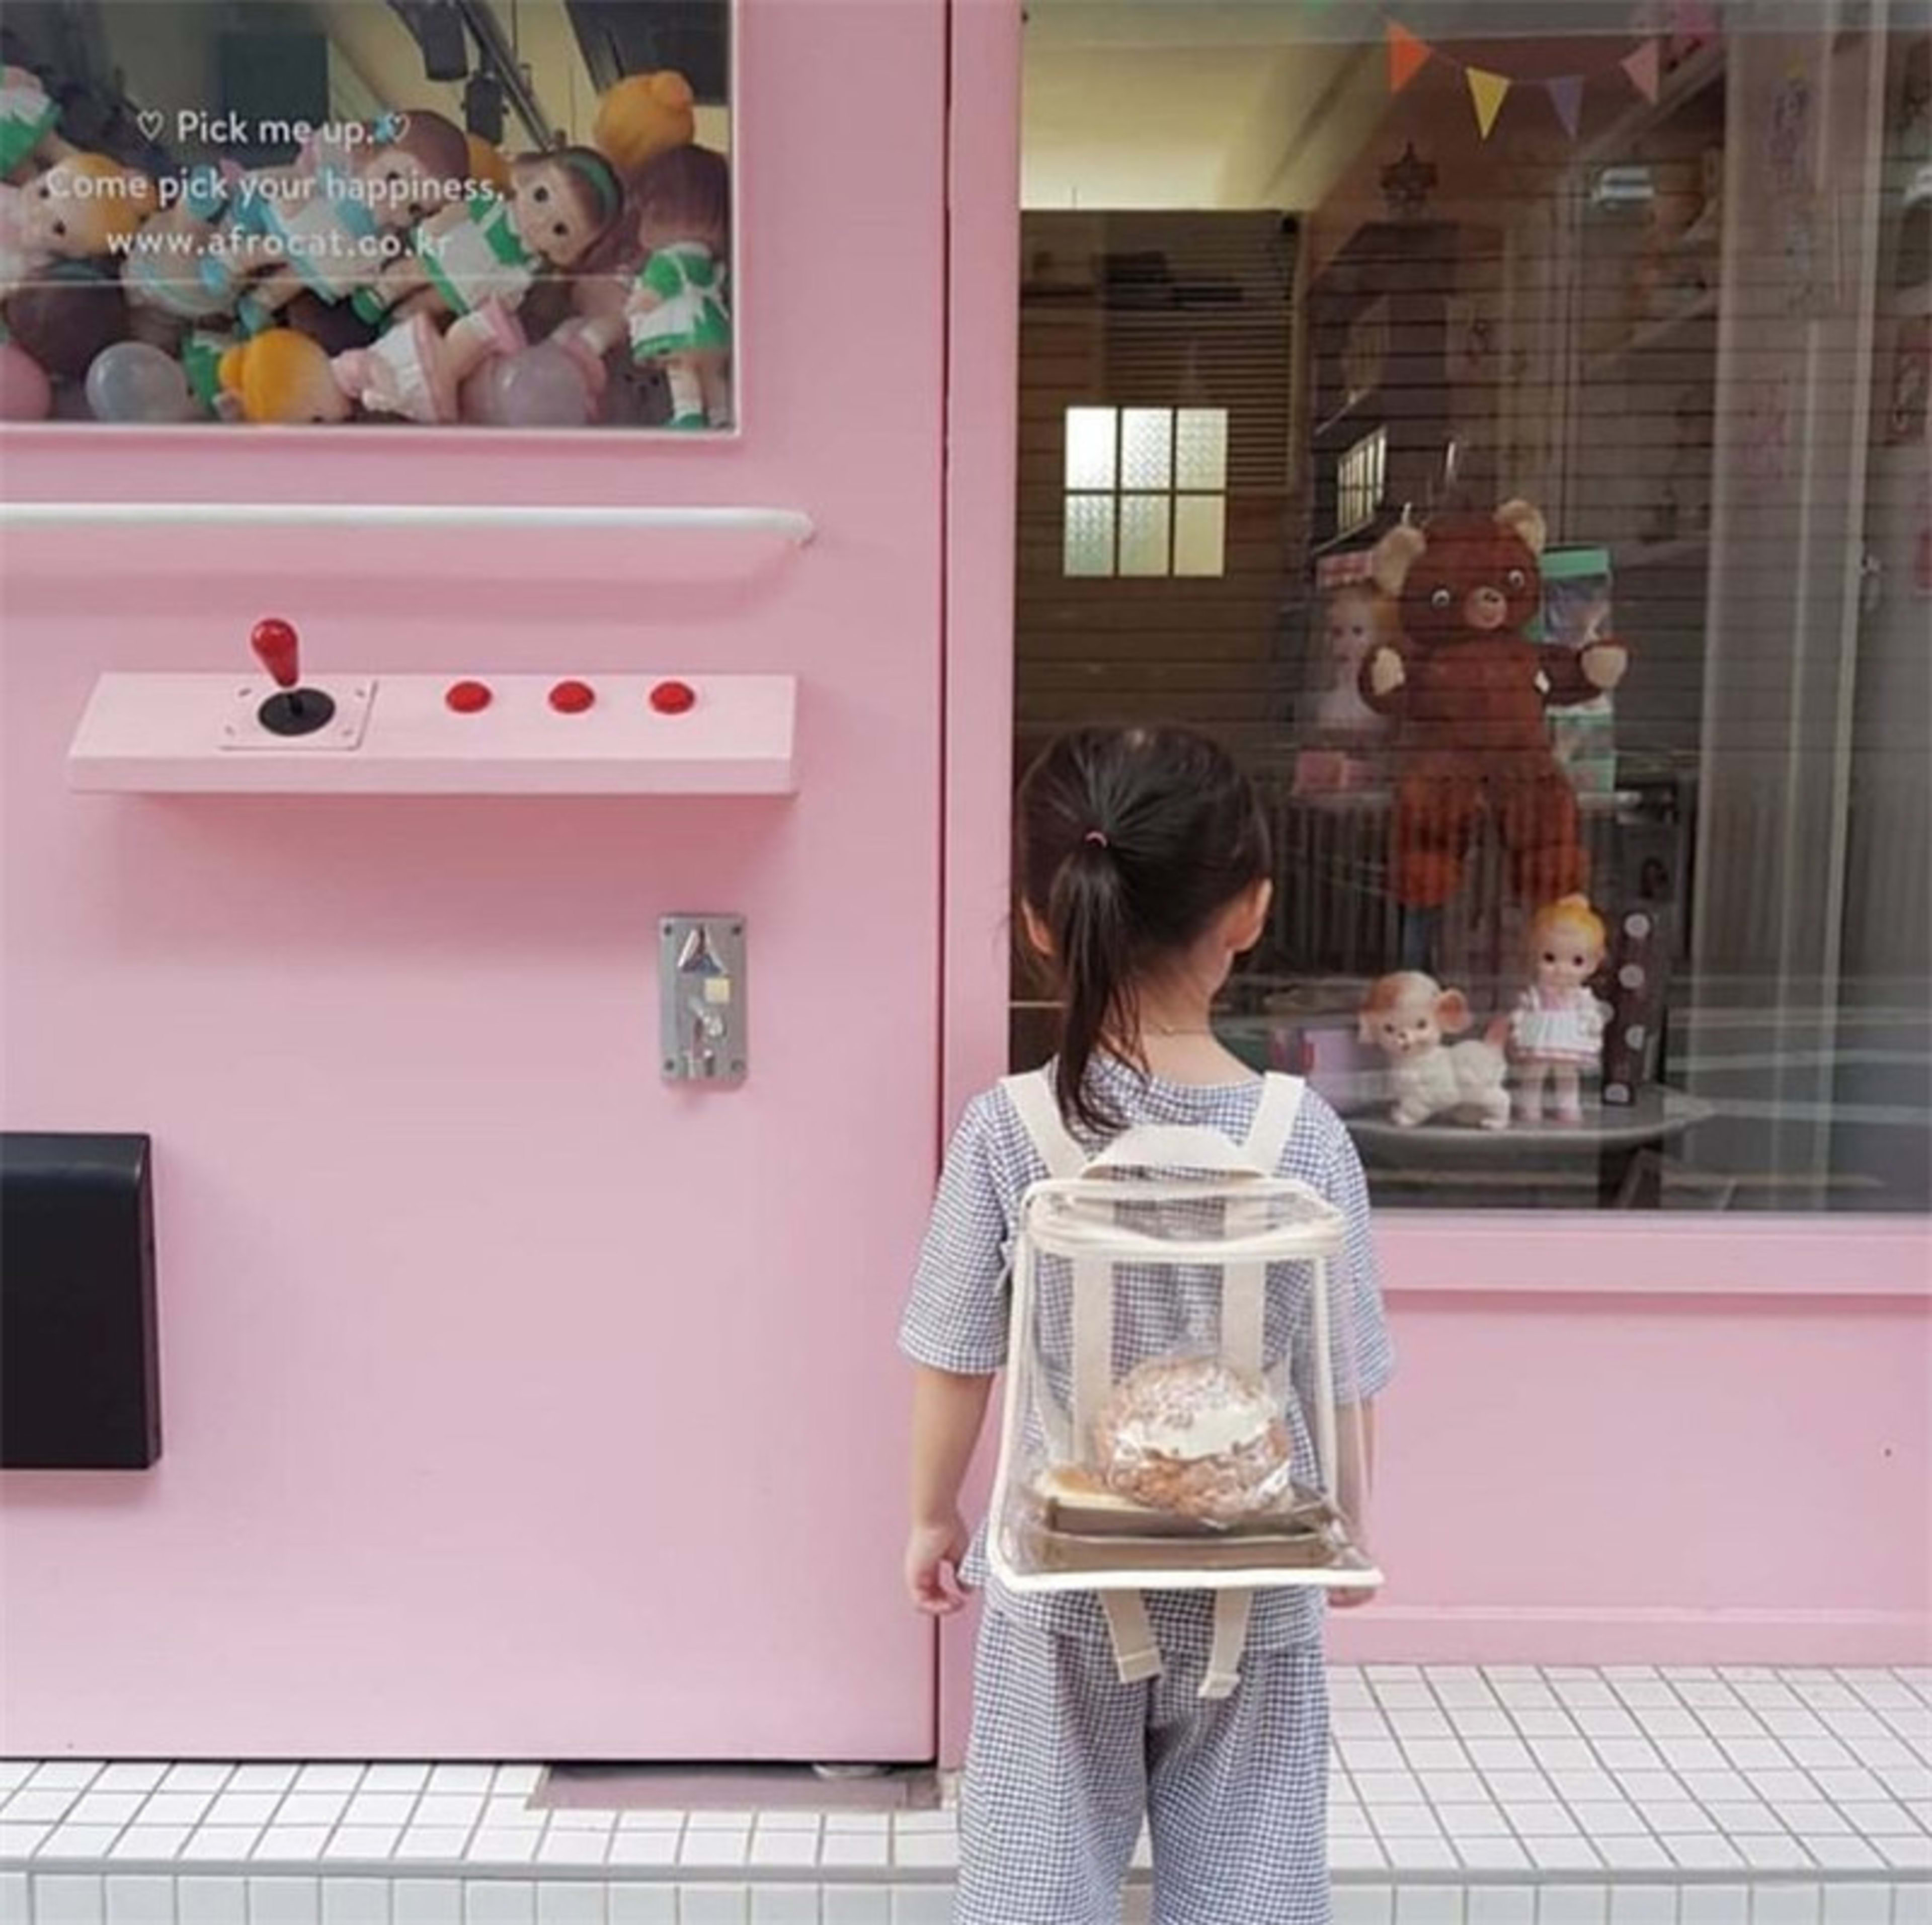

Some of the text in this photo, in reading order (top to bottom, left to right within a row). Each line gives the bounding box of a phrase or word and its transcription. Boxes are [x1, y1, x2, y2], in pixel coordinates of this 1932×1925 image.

[178, 111, 373, 151] Pick me up.
[47, 167, 148, 199] Come
[158, 168, 227, 207] pick
[238, 177, 315, 207] your
[106, 227, 449, 256] www.afrocat.co.kr
